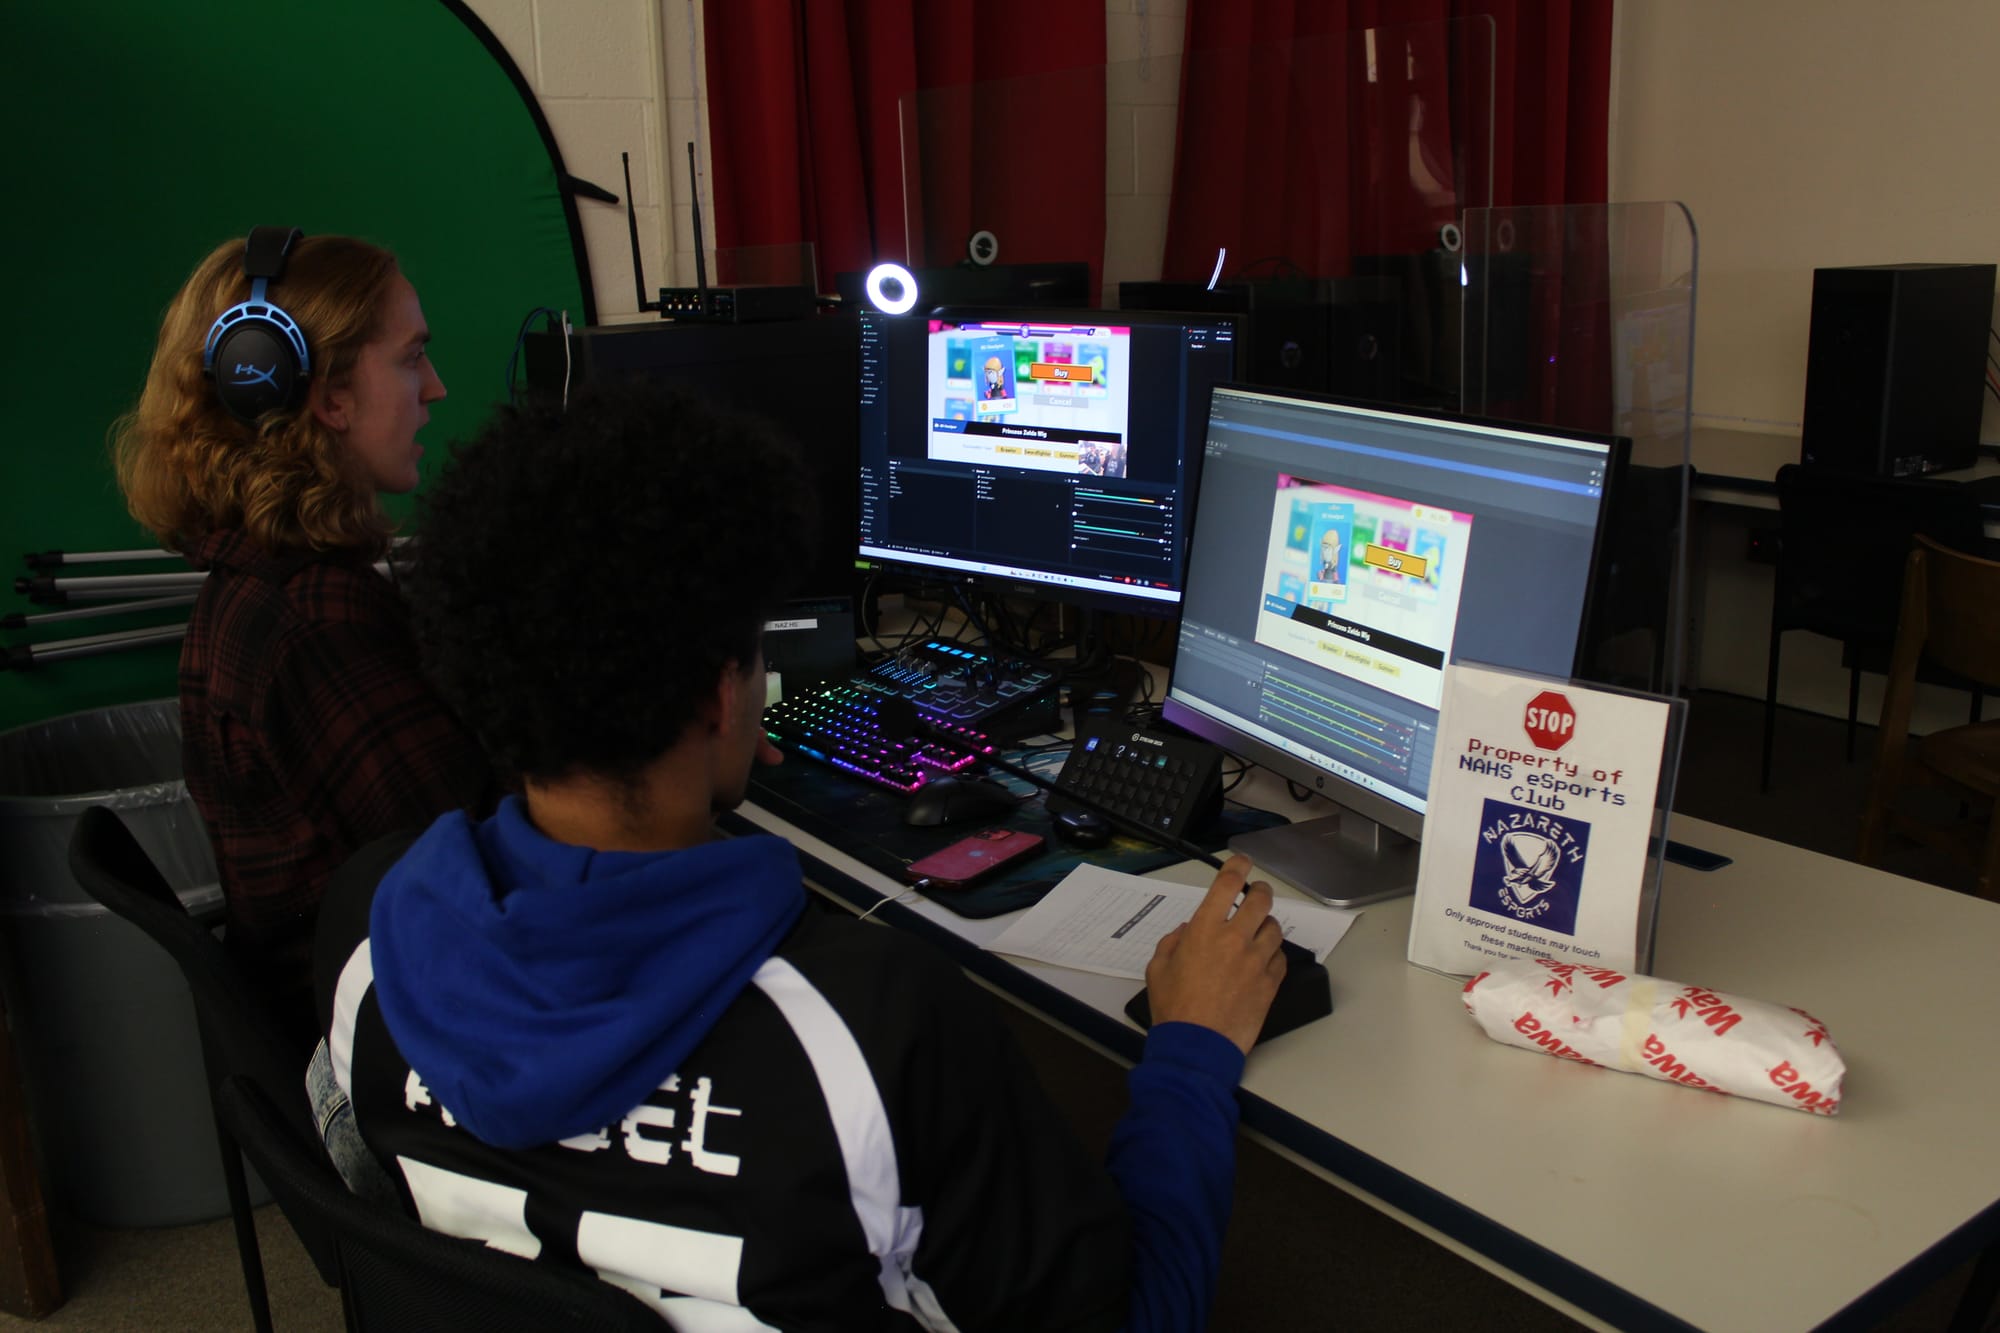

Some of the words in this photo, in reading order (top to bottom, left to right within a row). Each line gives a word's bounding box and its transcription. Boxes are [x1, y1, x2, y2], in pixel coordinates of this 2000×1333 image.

[1054, 368, 1068, 379] Buy
[1002, 427, 1022, 436] Princess
[1023, 429, 1037, 437] Zelda
[1388, 556, 1402, 569] Buy
[1327, 619, 1346, 632] Princess
[1346, 626, 1360, 637] Zelda
[1527, 707, 1573, 735] STOP
[1468, 738, 1578, 777] Property
[1593, 769, 1624, 785] of
[1459, 754, 1513, 780] NAHS
[1527, 773, 1626, 806] eSports
[1510, 785, 1565, 811] Club
[1482, 813, 1584, 863] NAZARETH
[1498, 887, 1550, 919] ESPORTS
[1445, 907, 1465, 923] Only
[1466, 915, 1506, 934] approved
[1508, 928, 1547, 945] students
[1550, 940, 1570, 953] may
[1572, 944, 1600, 959] touch
[1481, 933, 1505, 948] these
[1464, 940, 1483, 952] Thank
[1484, 947, 1497, 956] you
[1498, 951, 1508, 960] for
